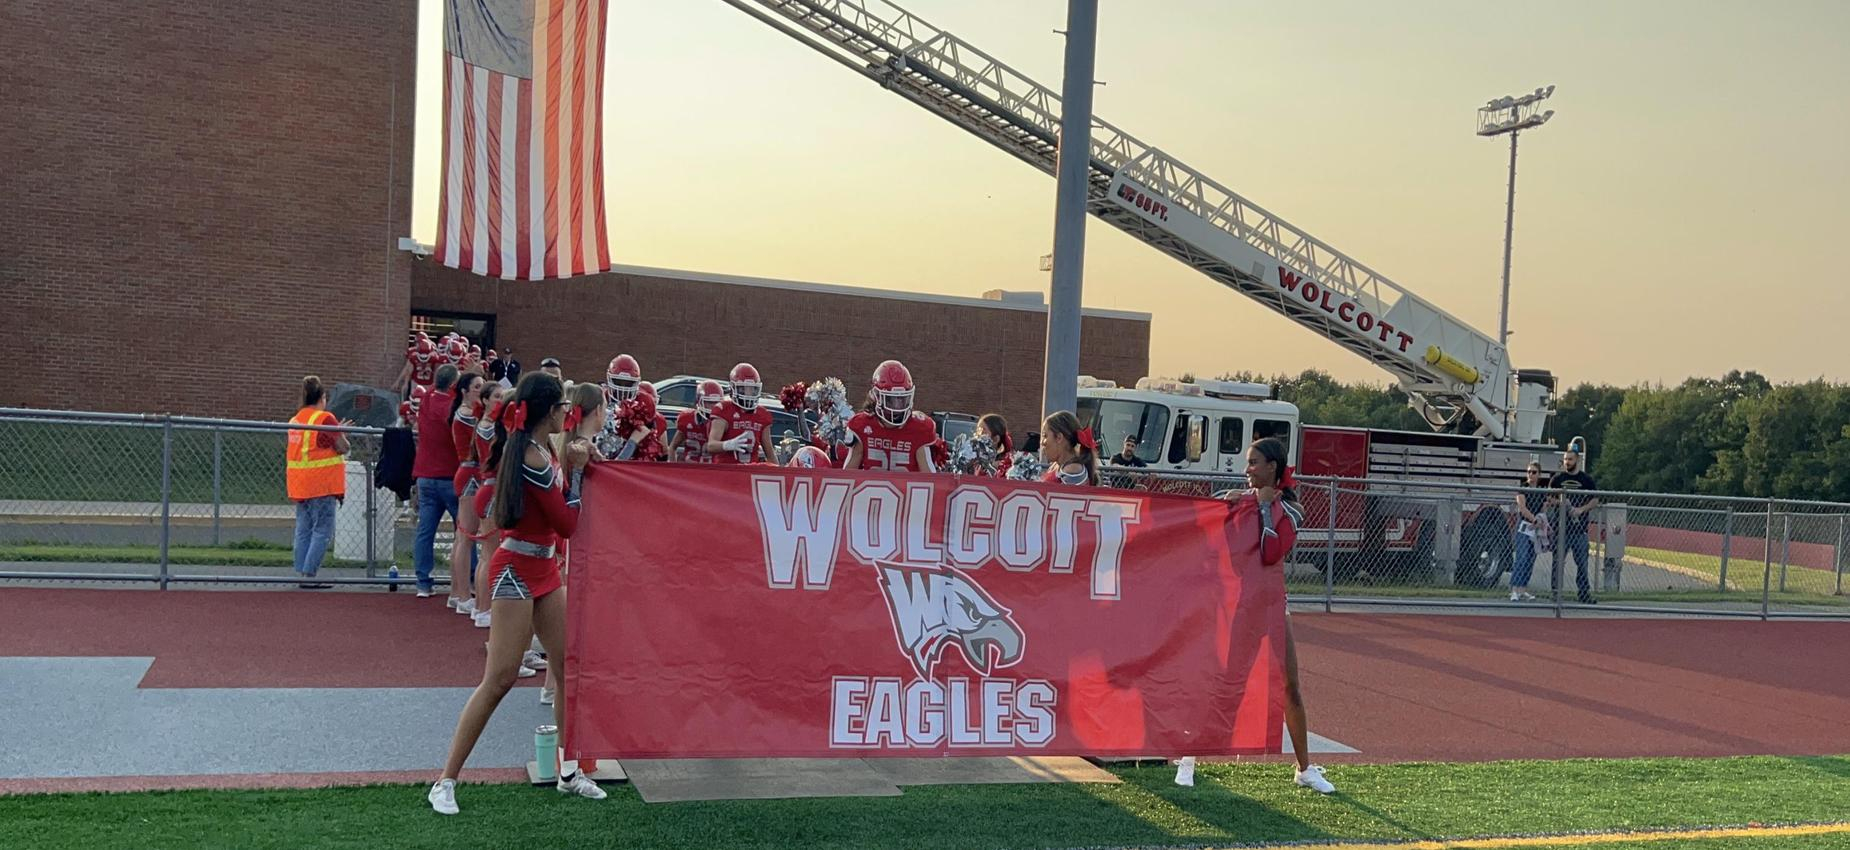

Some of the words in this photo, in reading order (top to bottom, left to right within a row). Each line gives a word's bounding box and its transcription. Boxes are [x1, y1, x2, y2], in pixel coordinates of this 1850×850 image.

[1278, 266, 1414, 352] WOLCOTT
[867, 437, 912, 451] EAGLES
[751, 474, 1143, 600] WOLCOTT
[829, 675, 1057, 749] EAGLES
